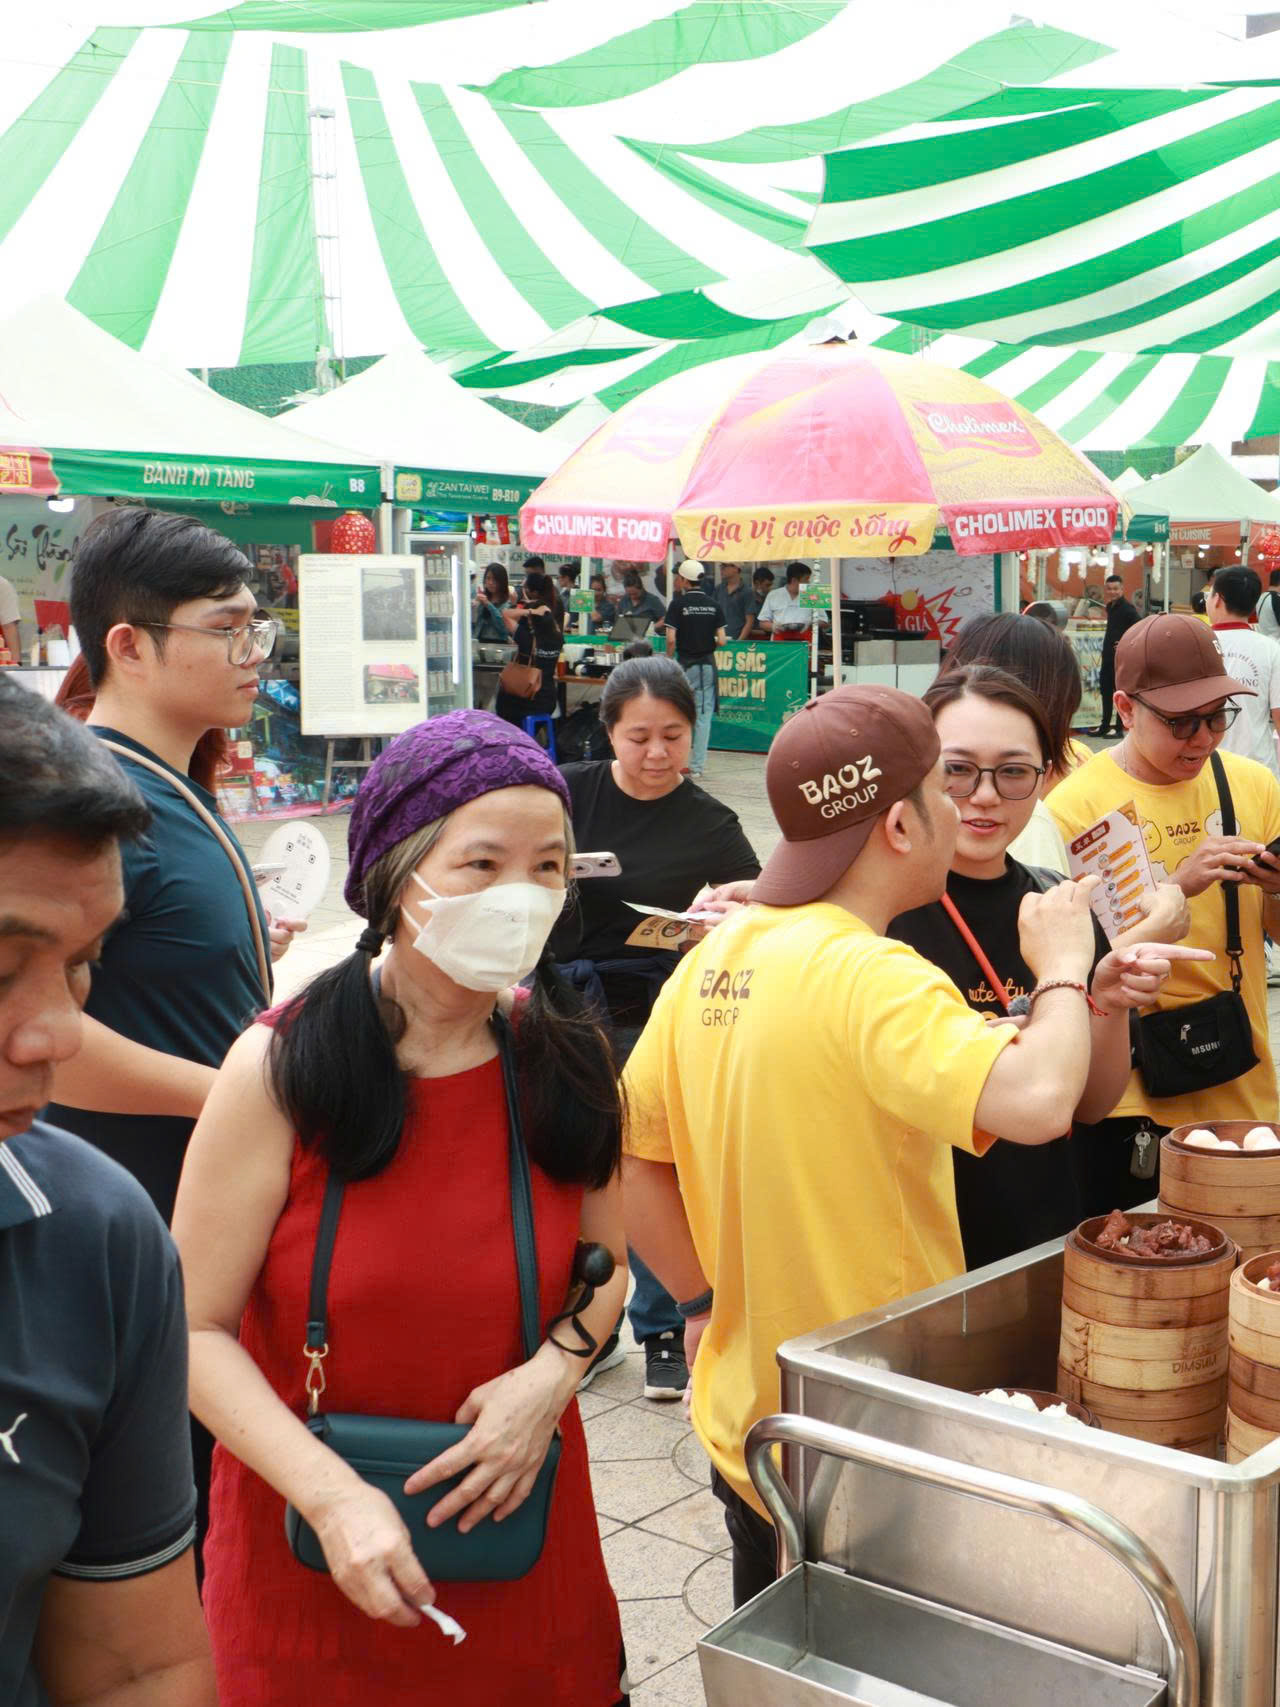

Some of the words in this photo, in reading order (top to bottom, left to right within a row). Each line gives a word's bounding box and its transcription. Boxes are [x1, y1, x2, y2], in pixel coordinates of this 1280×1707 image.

[533, 515, 614, 538] CHOLIMEX
[617, 518, 662, 542] FOOD
[696, 514, 743, 558] Gia
[751, 516, 776, 545] vị
[783, 513, 841, 544] cuộc
[850, 512, 917, 553] sống
[955, 509, 1057, 538] CHOLIMEX
[1062, 507, 1109, 528] FOOD
[798, 755, 883, 805] BAOZ
[821, 783, 879, 819] GROUP
[1166, 821, 1201, 837] BAOZ
